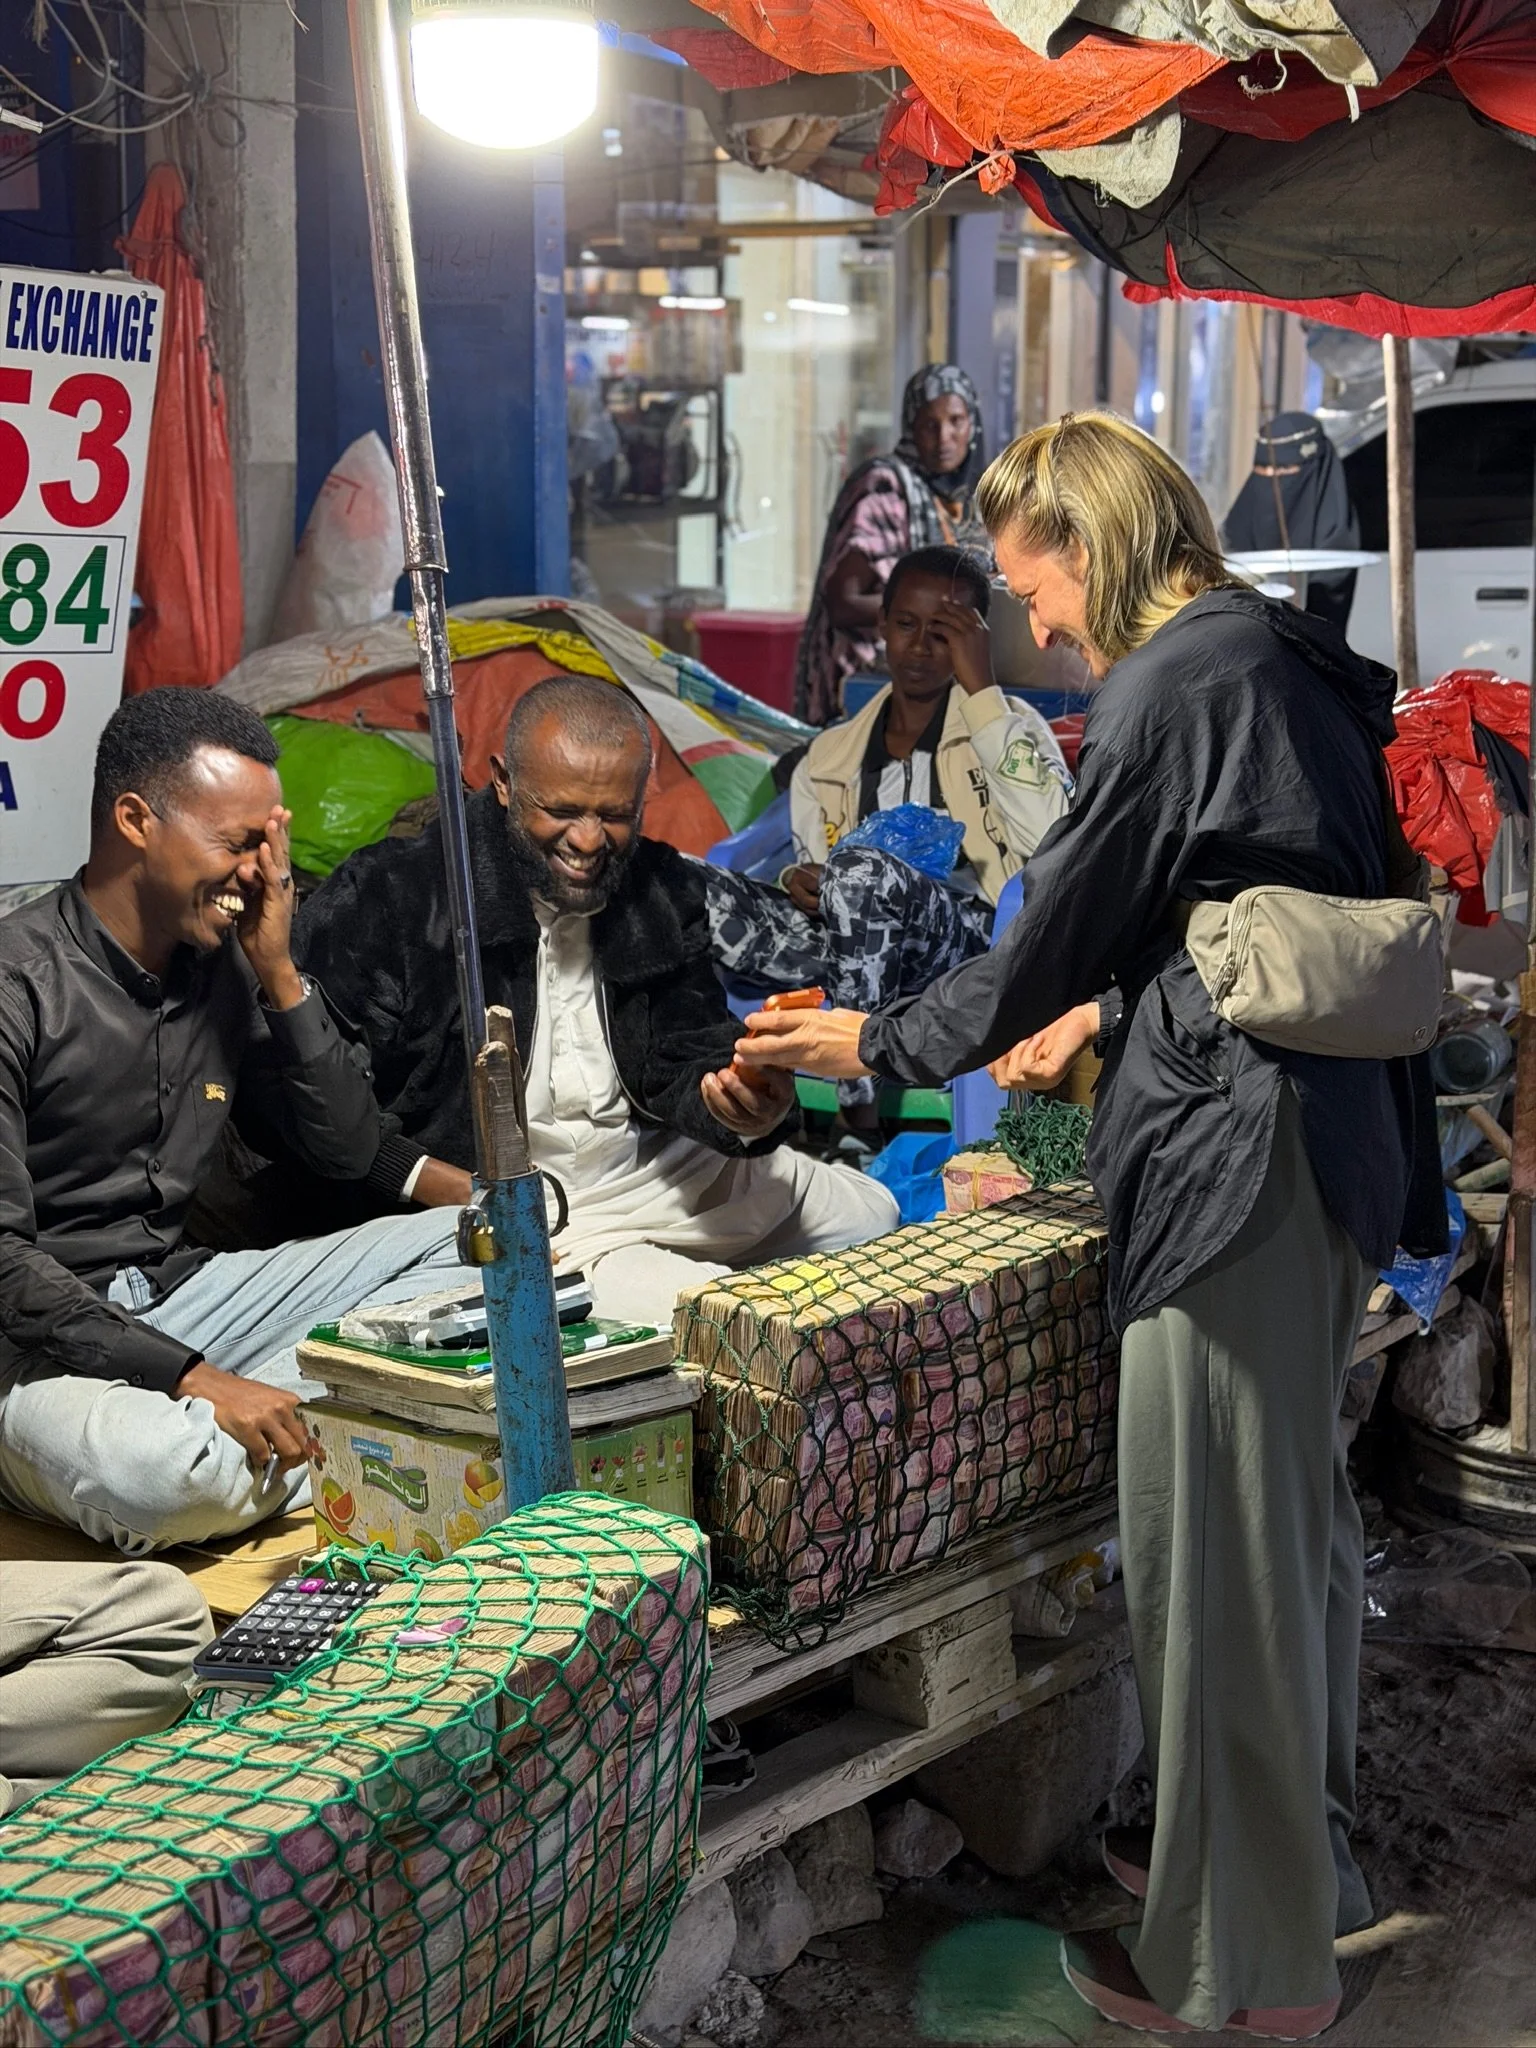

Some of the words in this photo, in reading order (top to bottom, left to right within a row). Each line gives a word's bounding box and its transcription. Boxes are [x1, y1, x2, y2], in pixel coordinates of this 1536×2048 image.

[5, 282, 158, 363] EXCHANGE
[0, 543, 110, 646] 84
[285, 1579, 298, 1587] 0
[268, 1592, 285, 1603] 00
[311, 1596, 323, 1604] 4
[334, 1597, 347, 1605] 7
[298, 1608, 311, 1616] 5
[306, 1623, 318, 1631] 9
